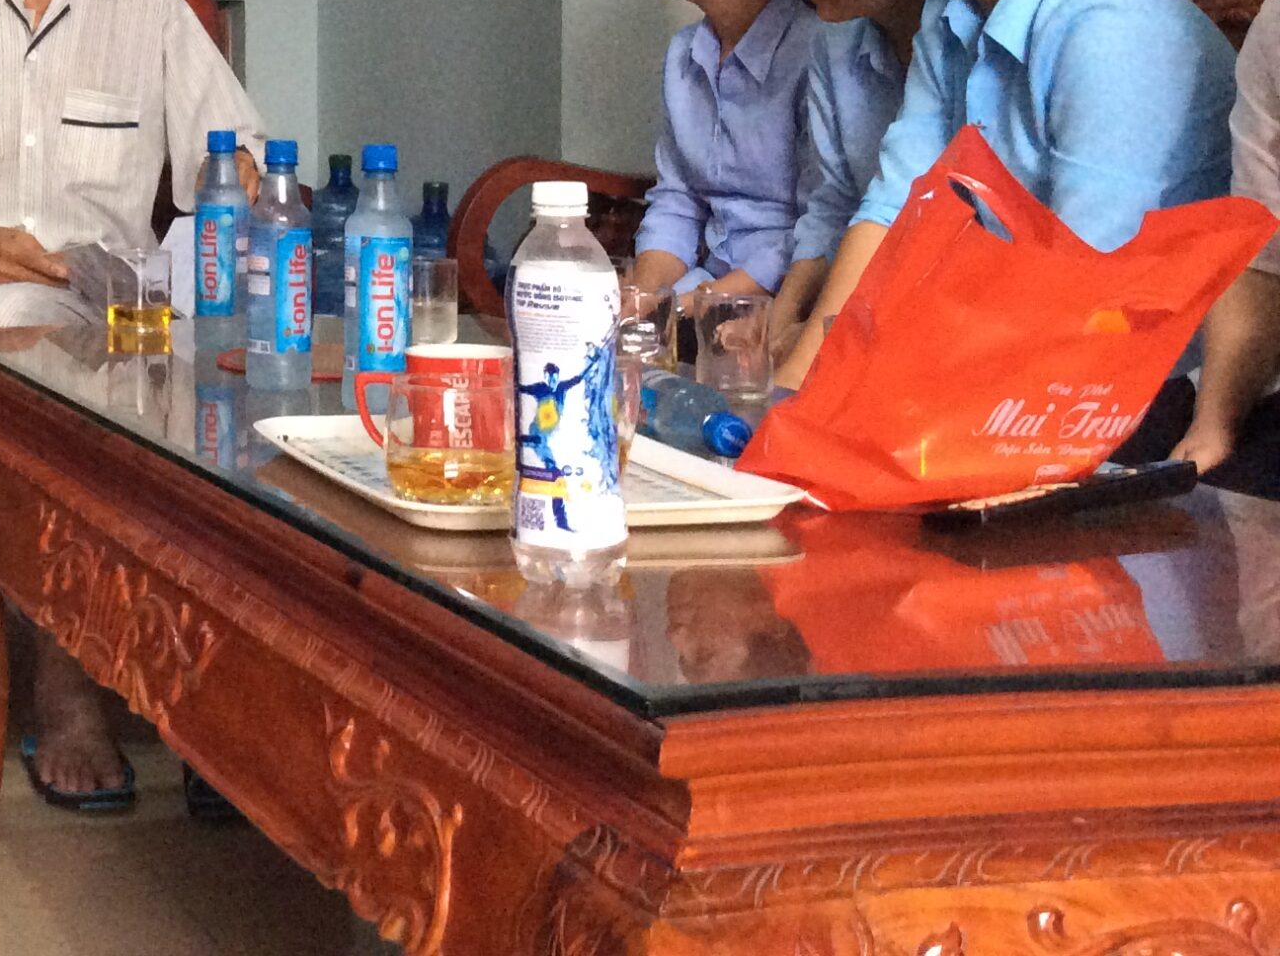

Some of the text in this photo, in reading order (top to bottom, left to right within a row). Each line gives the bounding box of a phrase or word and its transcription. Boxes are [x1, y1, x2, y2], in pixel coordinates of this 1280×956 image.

[199, 219, 218, 258] Life
[287, 244, 307, 288] Life
[370, 254, 395, 301] Life
[444, 374, 473, 448] ESCAFÉ
[971, 398, 1057, 437] Mai
